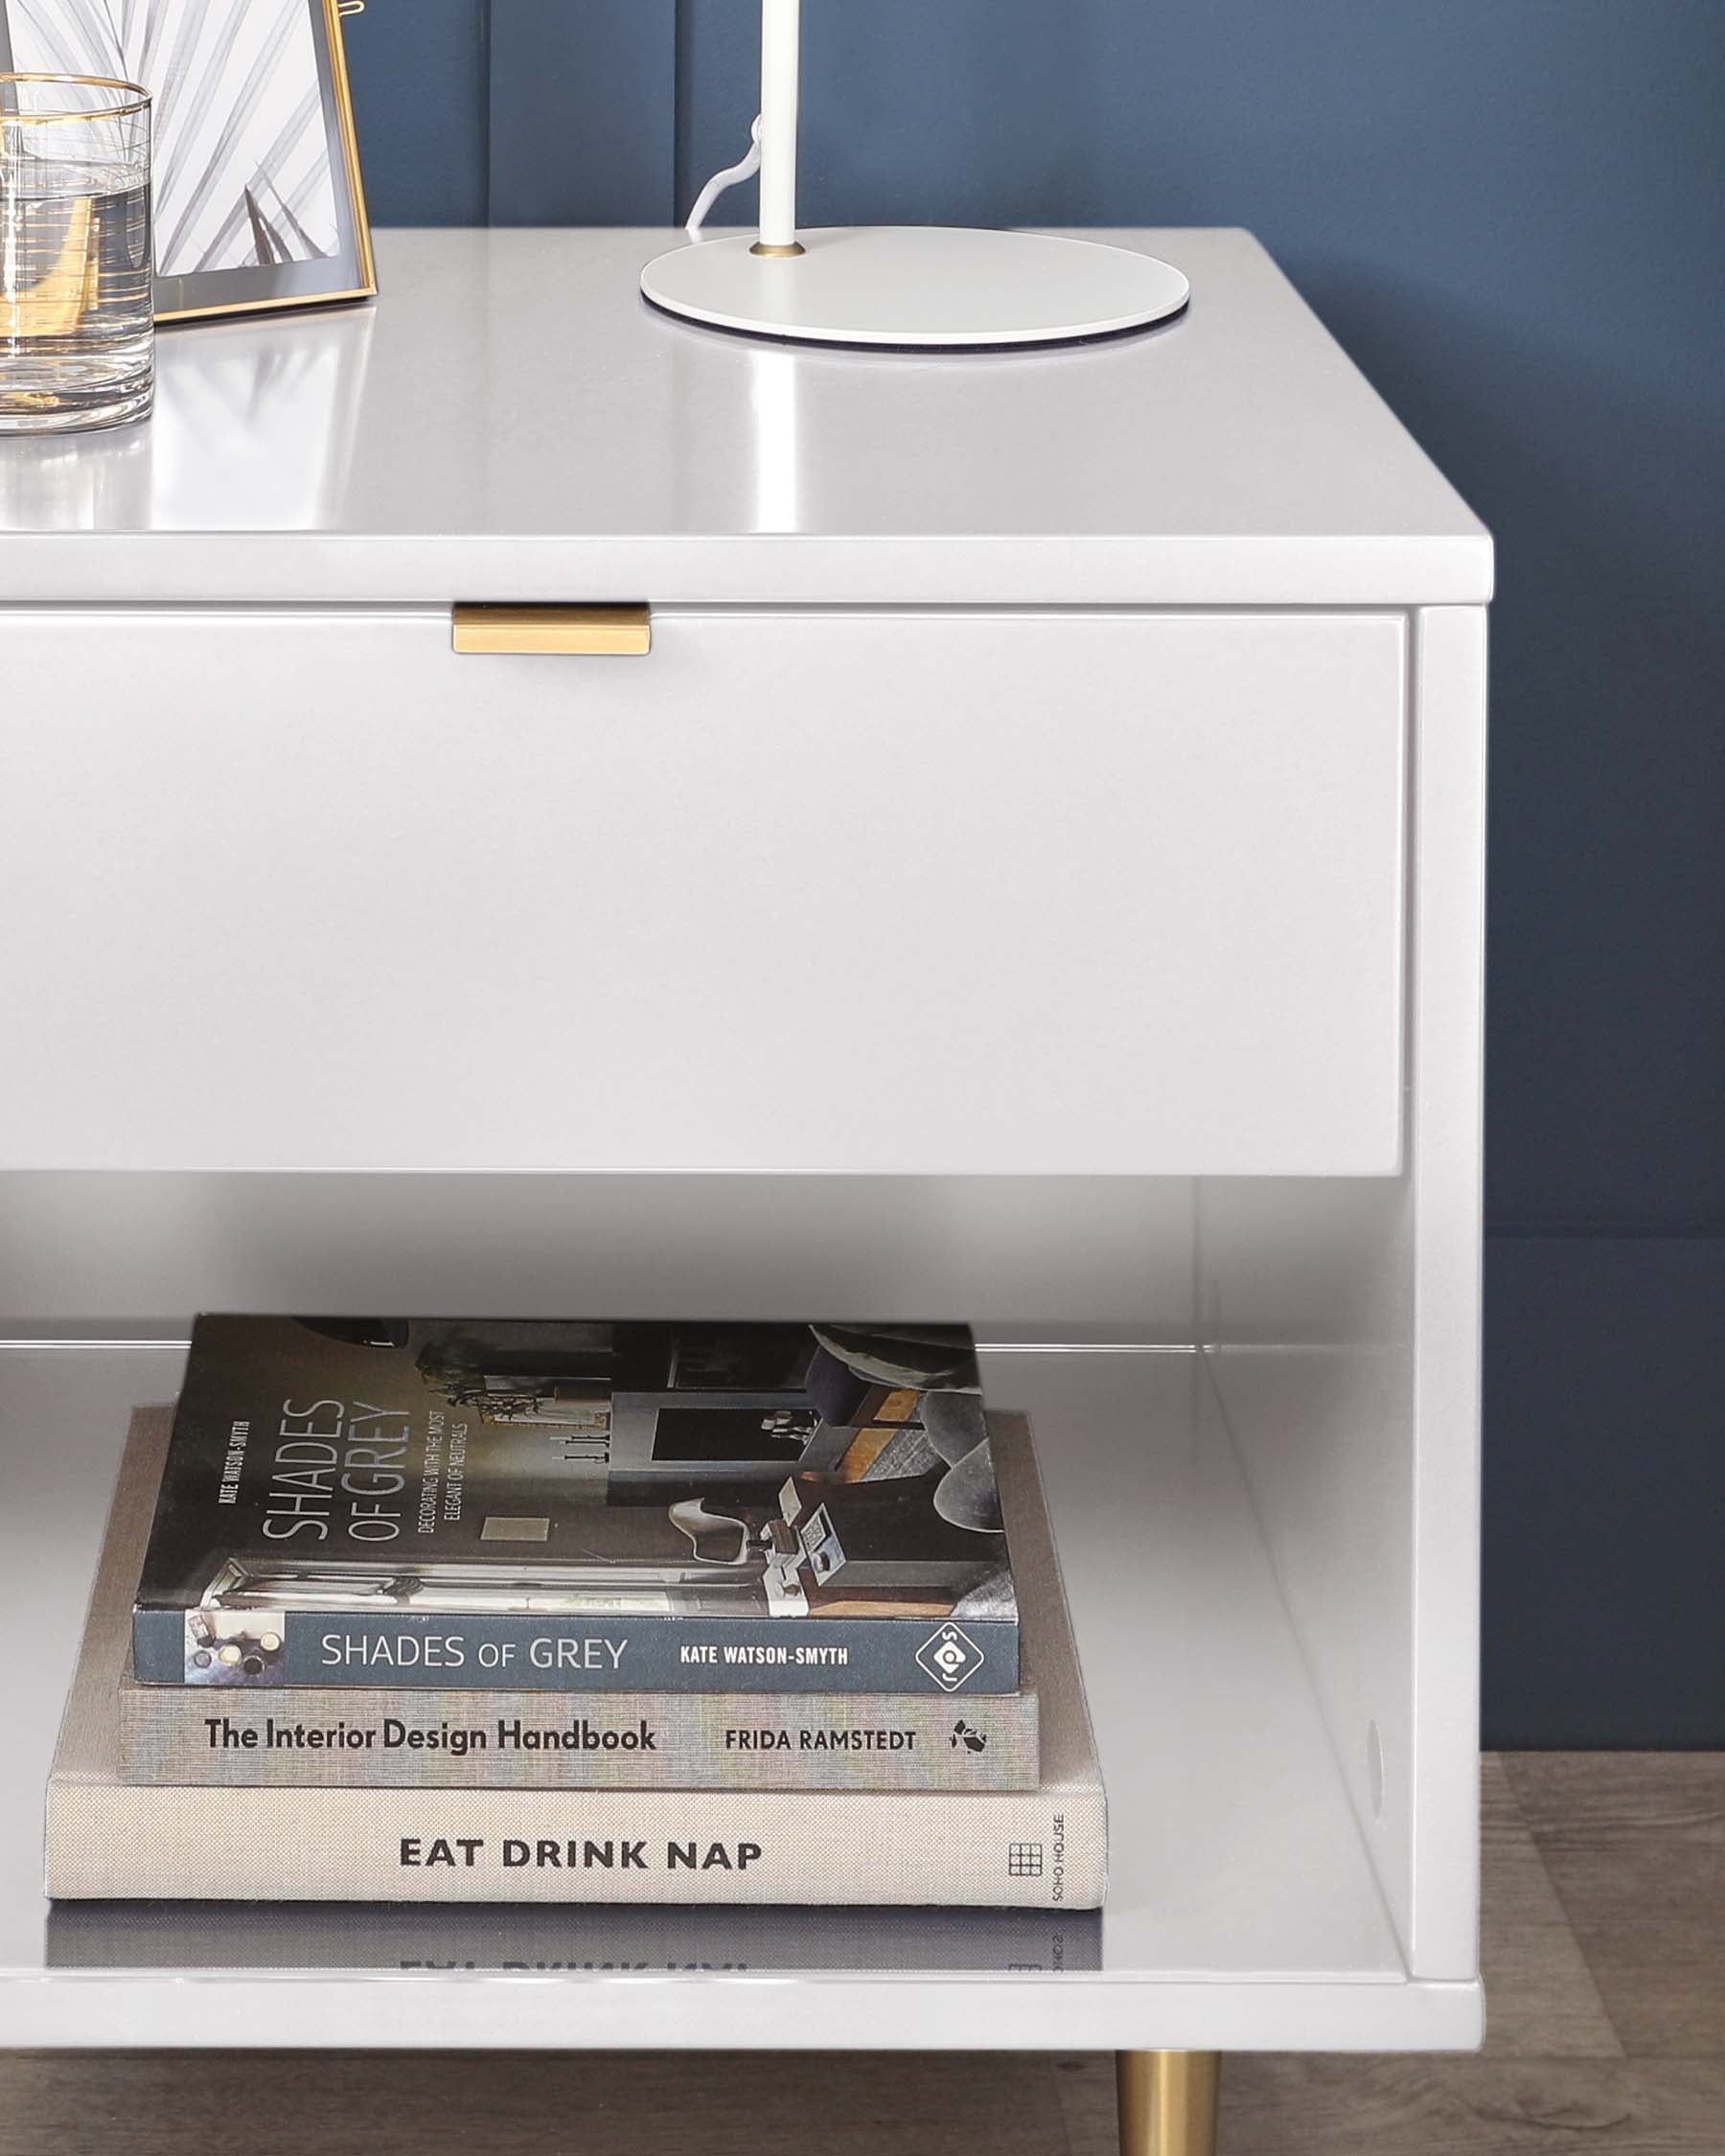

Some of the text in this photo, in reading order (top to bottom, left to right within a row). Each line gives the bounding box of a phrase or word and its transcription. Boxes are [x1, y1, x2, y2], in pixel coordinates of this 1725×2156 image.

[218, 1421, 250, 1503] KATE WATSON-SMYTH
[263, 1399, 345, 1540] SHADES
[341, 1401, 410, 1542] OF GREY
[418, 1411, 445, 1533] DECORATING WITH THE MOST
[444, 1423, 469, 1521] ELEGANT OF NEUTRALS
[321, 1634, 629, 1669] SHADES OF GREY
[680, 1645, 848, 1665] KATE WATSON-SMYTH
[204, 1718, 656, 1755] The Interior Design Handbook
[725, 1730, 916, 1751] FRIDA RAMSTEDT
[400, 1838, 762, 1869] EAT DRINK NAP
[1052, 1813, 1065, 1902] SOHO HOUSE
